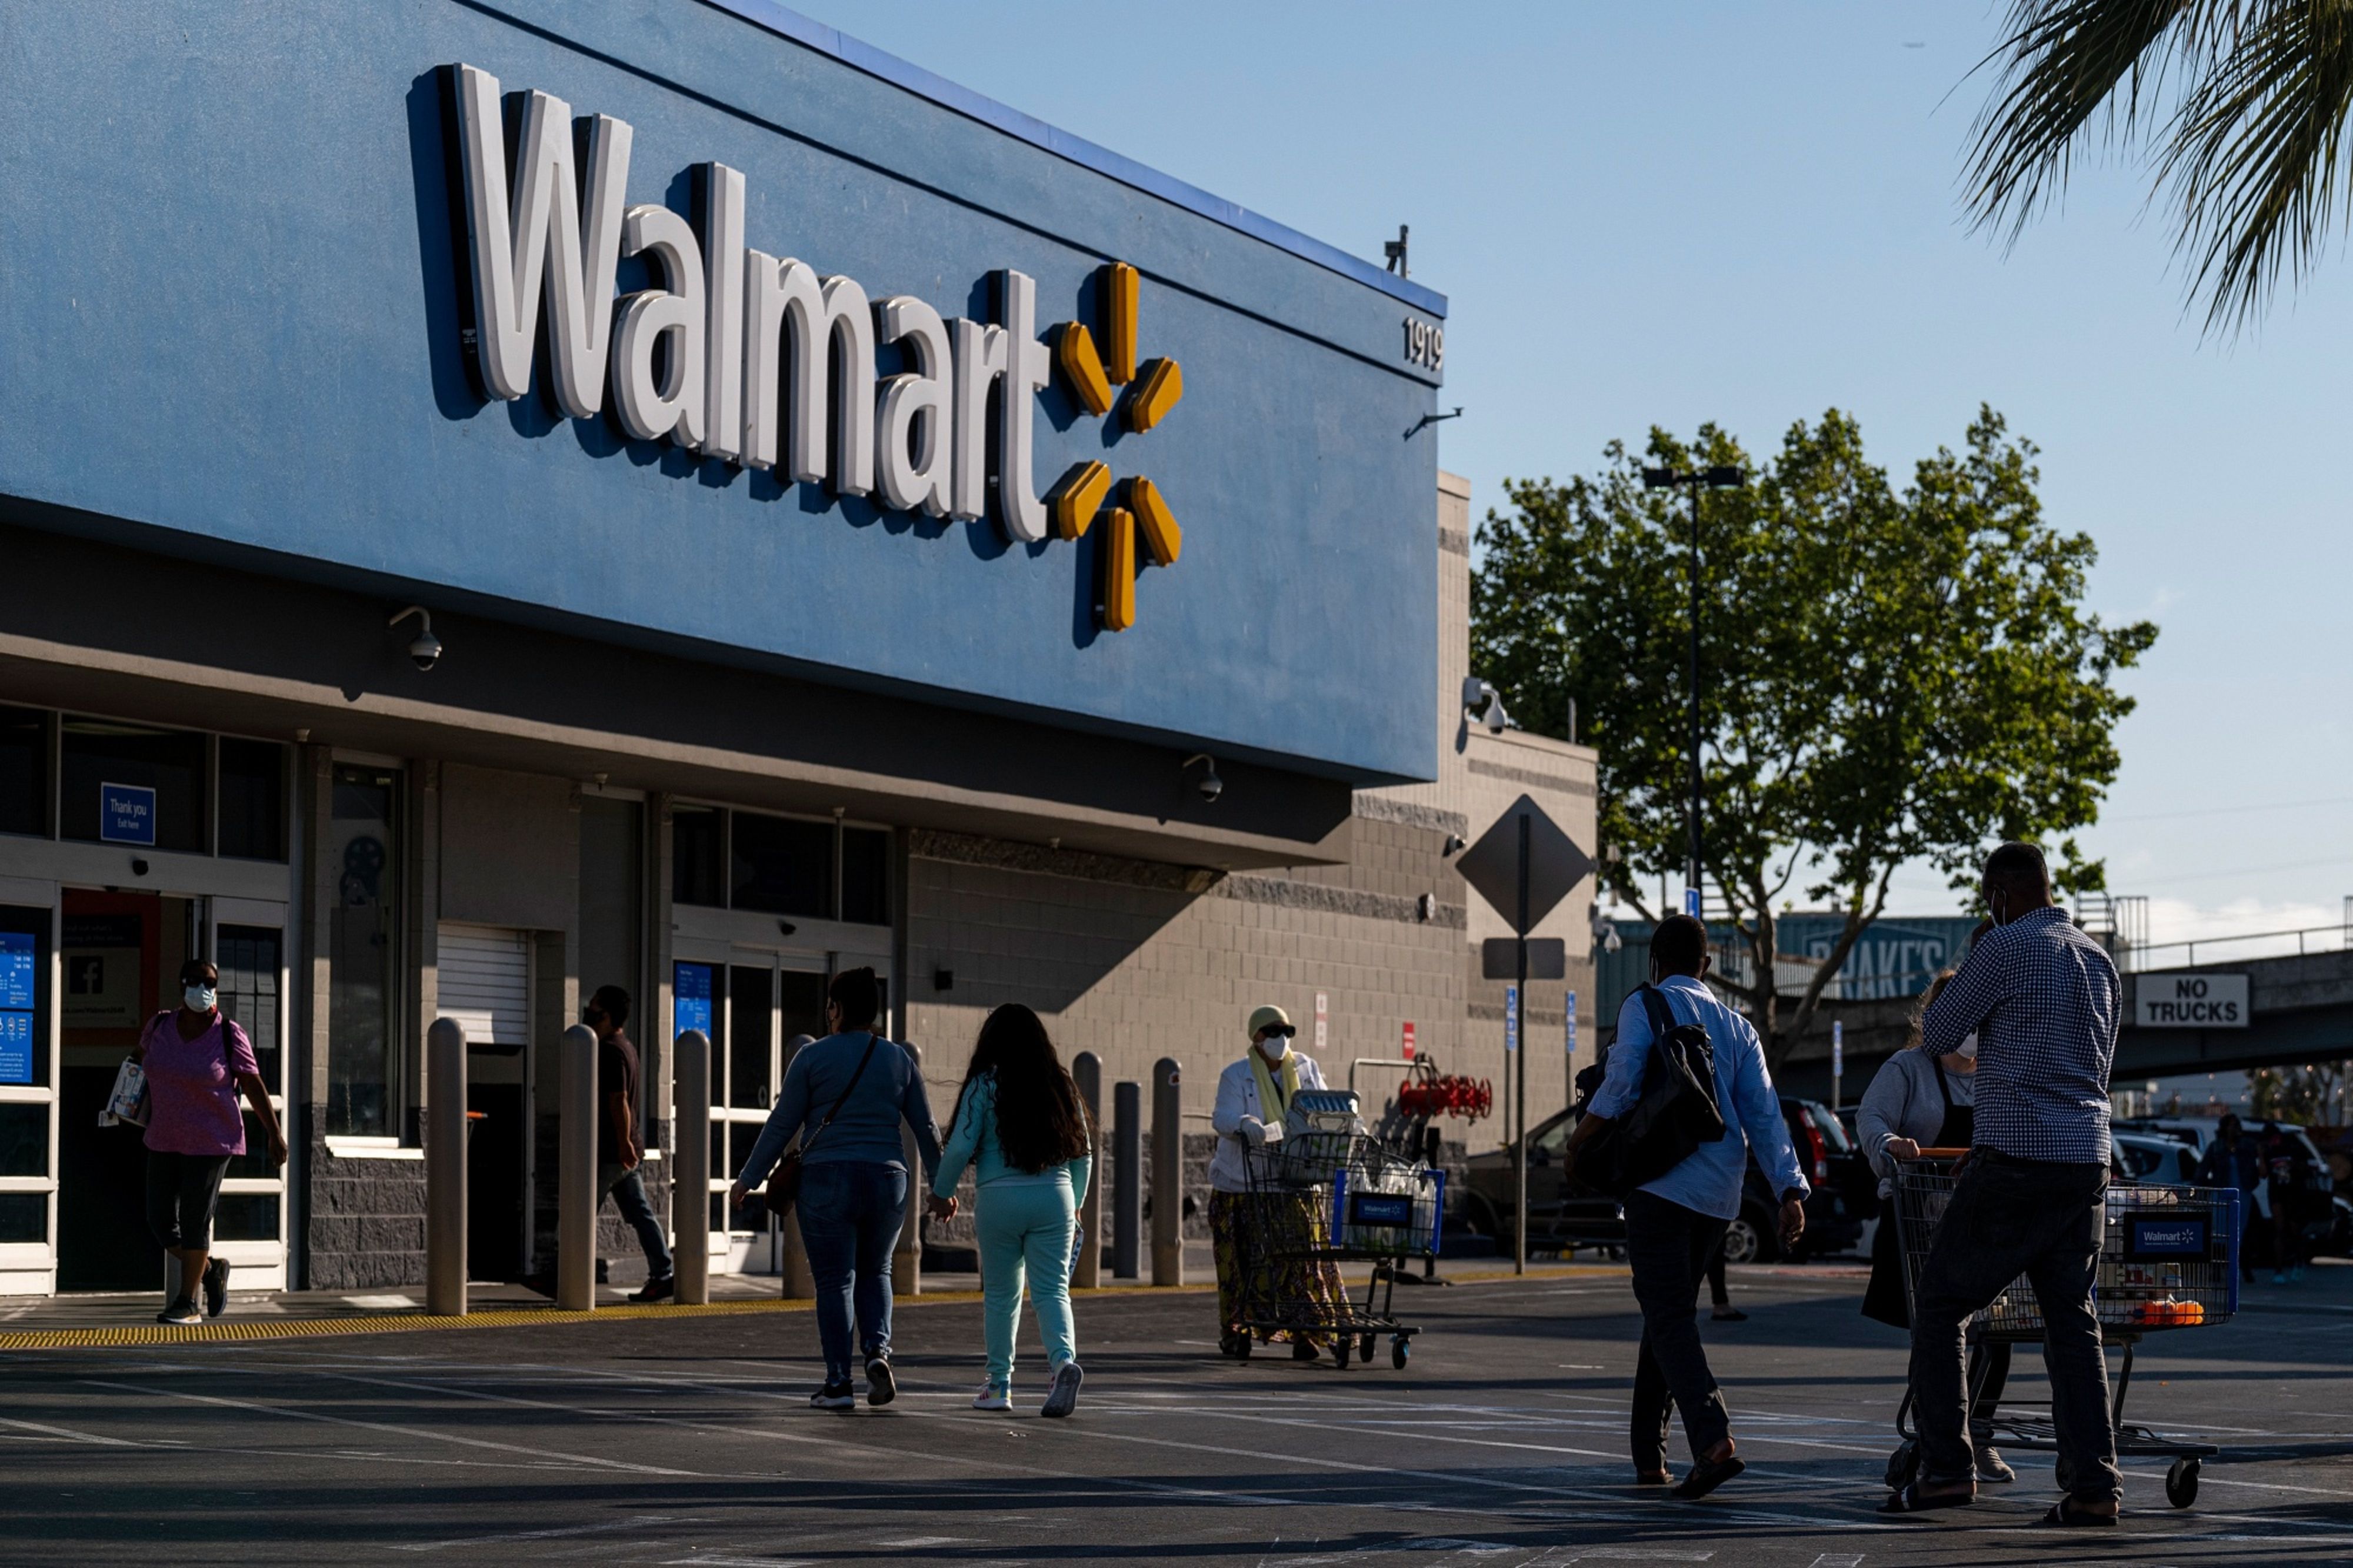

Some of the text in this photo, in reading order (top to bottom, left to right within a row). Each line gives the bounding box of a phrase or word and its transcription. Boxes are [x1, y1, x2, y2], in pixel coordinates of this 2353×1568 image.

[459, 62, 1050, 543] Walmart
[1406, 316, 1444, 371] 1919
[110, 798, 146, 818] Thank you
[83, 962, 99, 993] f
[2177, 979, 2208, 998] NO
[2147, 1001, 2238, 1021] TRUCKS
[1364, 1204, 1391, 1214] Walmart
[2144, 1231, 2180, 1241] Walmart
